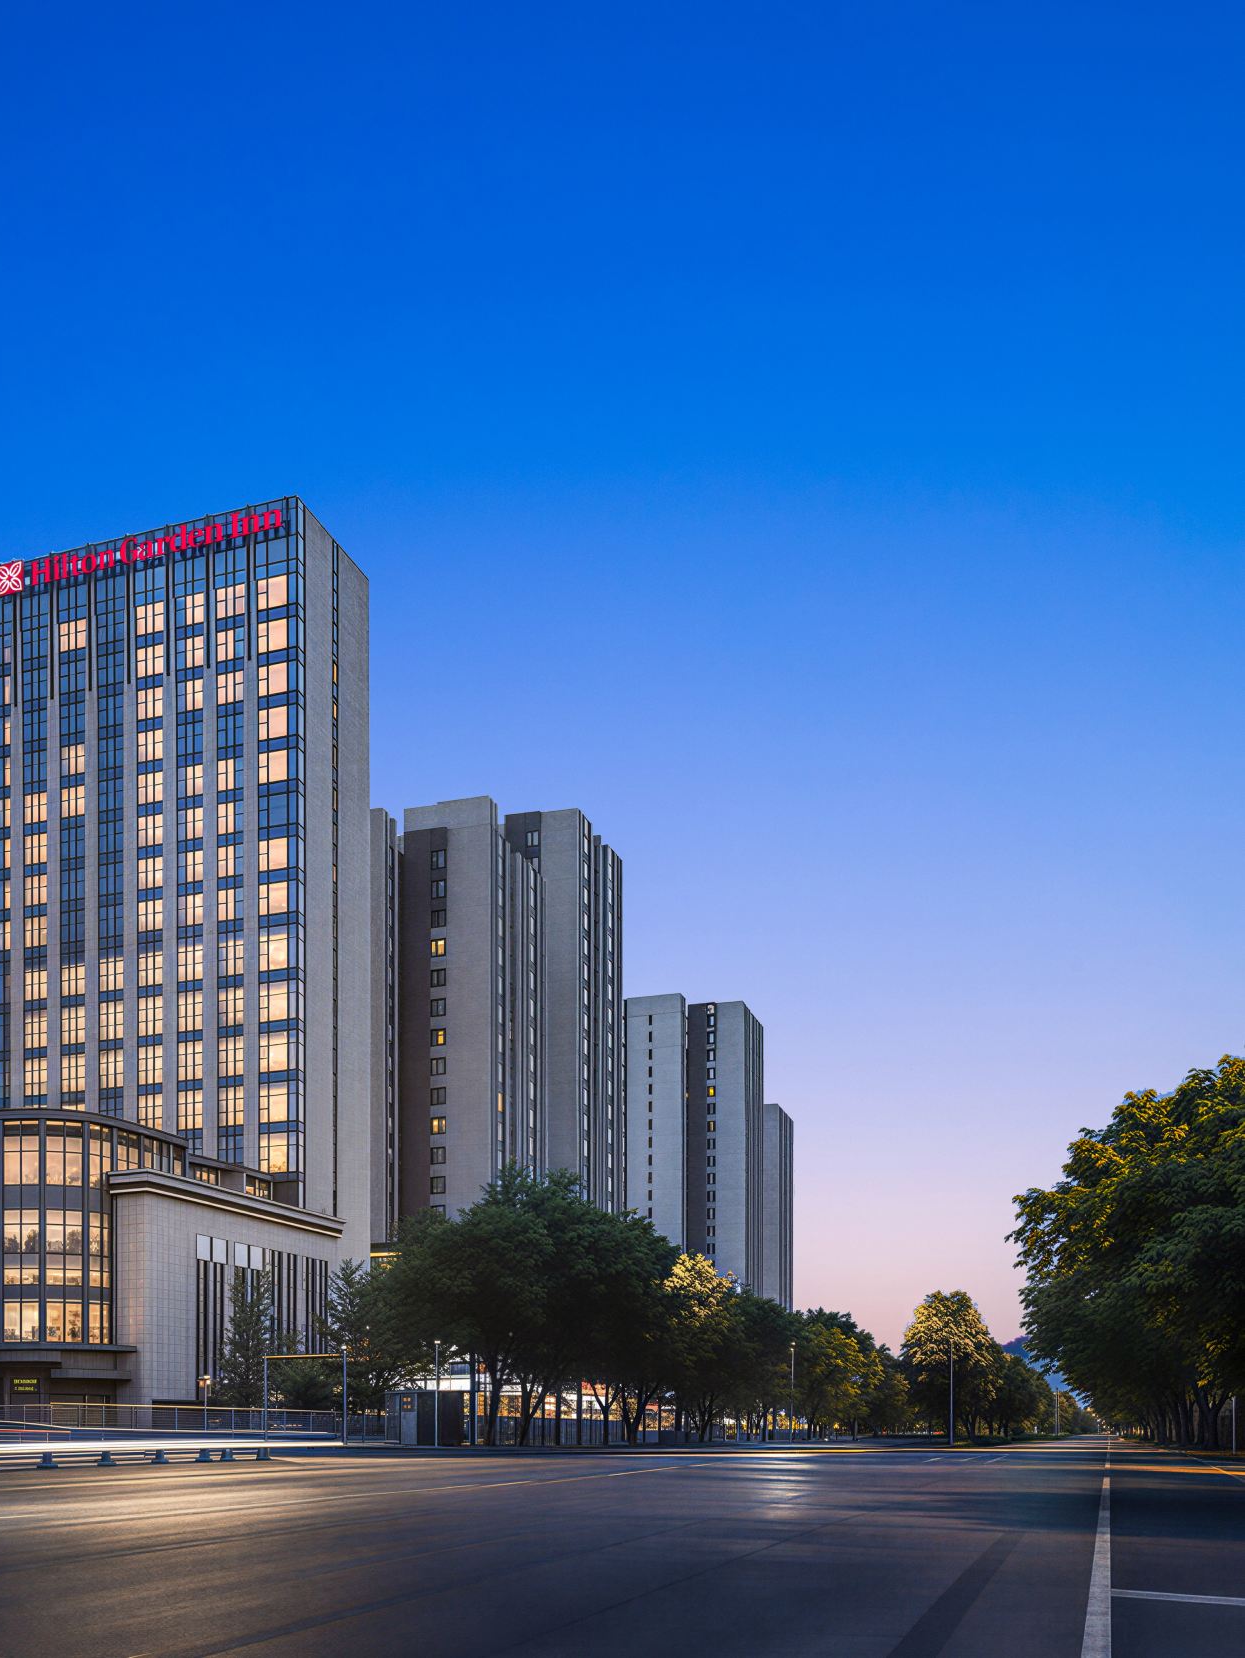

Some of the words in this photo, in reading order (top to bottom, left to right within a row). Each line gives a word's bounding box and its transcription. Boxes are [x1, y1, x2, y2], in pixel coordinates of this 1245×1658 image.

[31, 551, 115, 586] Hilton
[120, 524, 223, 564] Garden
[231, 508, 283, 538] Inn
